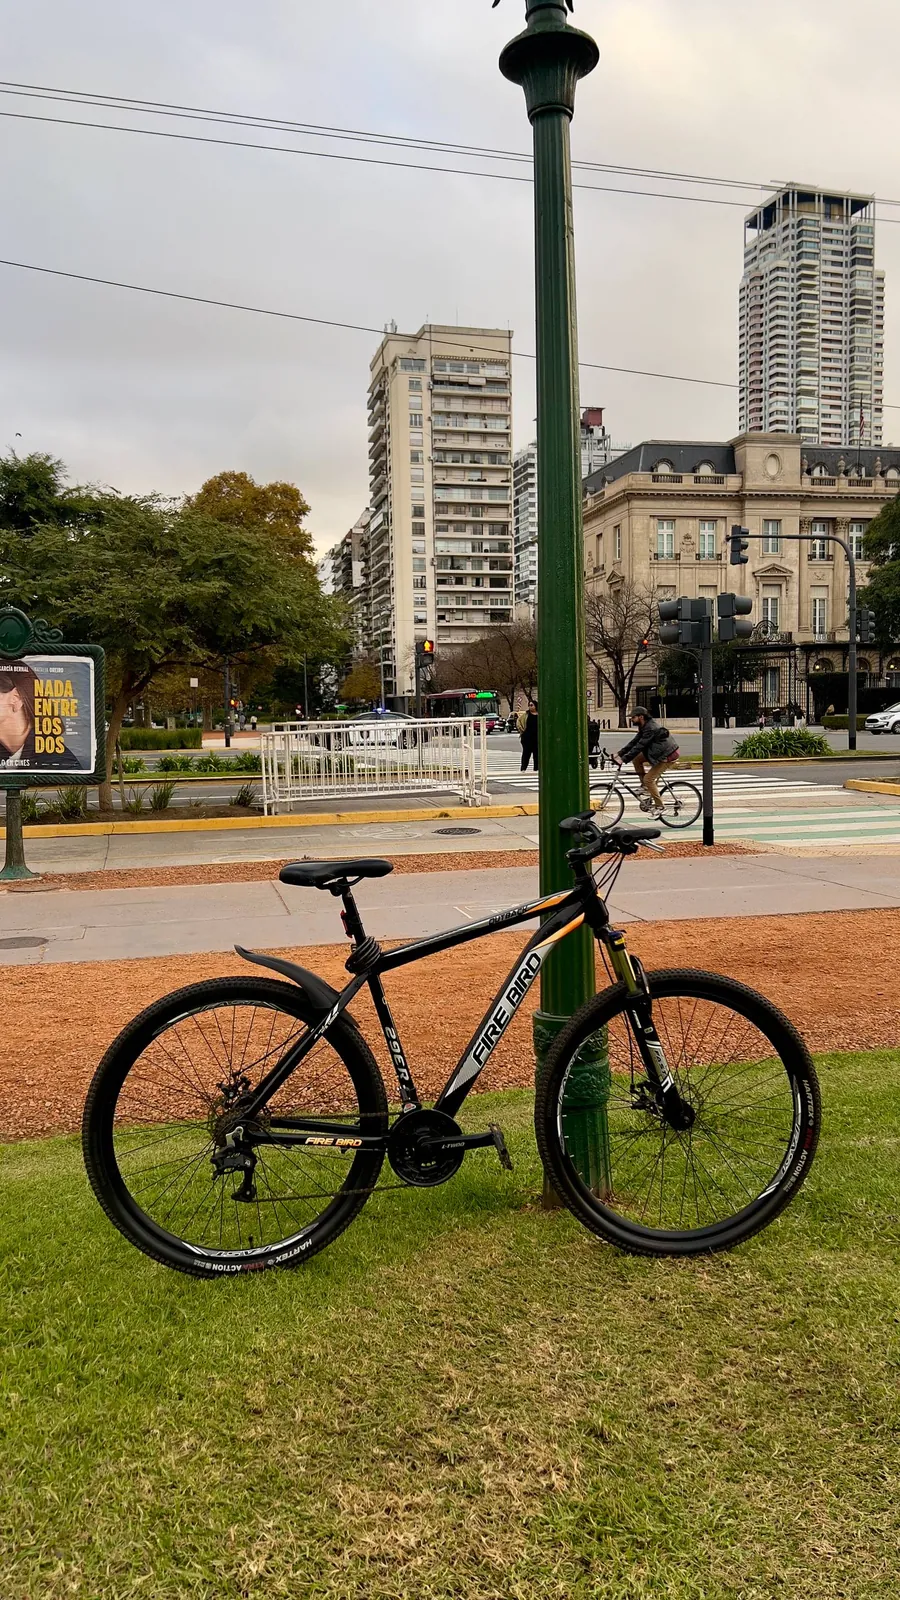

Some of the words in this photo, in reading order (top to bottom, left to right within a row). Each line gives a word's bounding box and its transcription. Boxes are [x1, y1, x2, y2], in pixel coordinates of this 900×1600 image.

[34, 679, 73, 697] NADA
[34, 698, 78, 717] ENTRE
[34, 717, 62, 735] LOS
[35, 736, 65, 754] DOS
[473, 1006, 509, 1067] FIRE
[506, 953, 542, 1008] BIRD
[385, 1026, 409, 1081] 29ER
[802, 1079, 814, 1119] HARTEX
[305, 1136, 333, 1146] FIRE
[335, 1137, 363, 1147] BIRD
[793, 1149, 808, 1177] ACTION
[275, 1238, 313, 1263] HARTEX
[212, 1262, 242, 1272] ACTION
